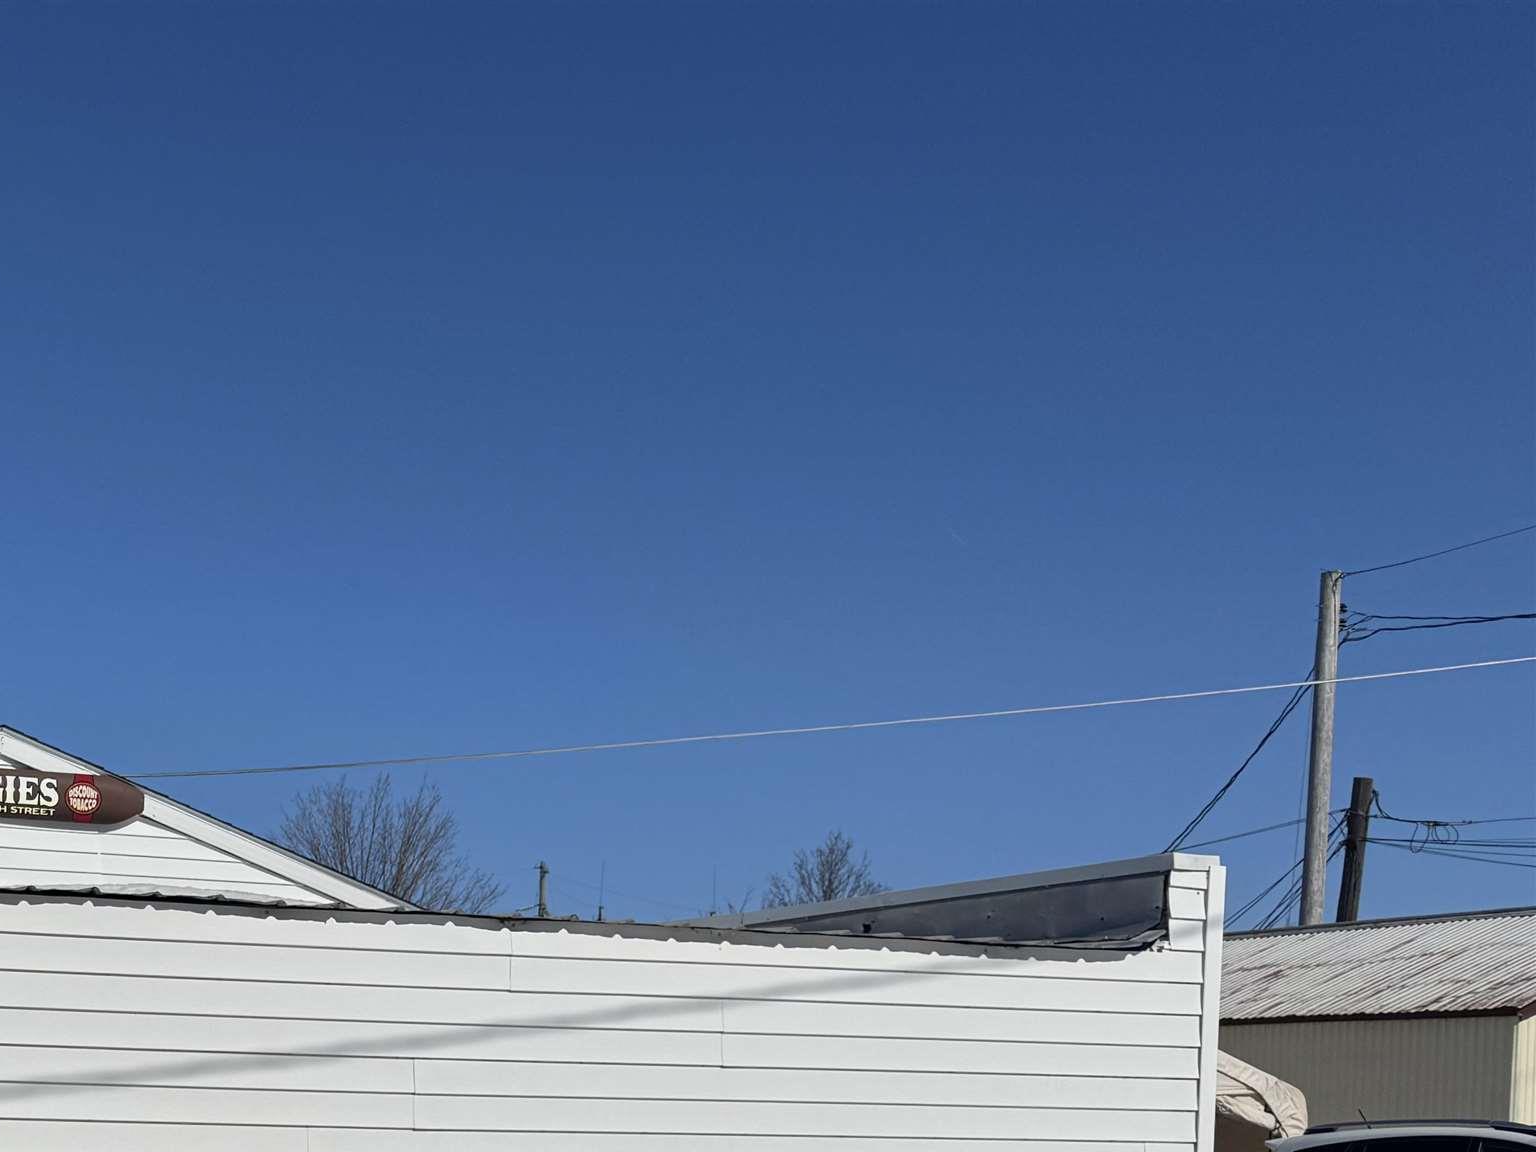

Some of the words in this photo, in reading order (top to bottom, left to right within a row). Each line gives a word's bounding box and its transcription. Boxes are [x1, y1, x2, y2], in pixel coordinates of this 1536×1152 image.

[68, 785, 98, 799] DISCOUNT
[10, 805, 56, 816] STREET
[69, 797, 97, 811] TOBACCO
